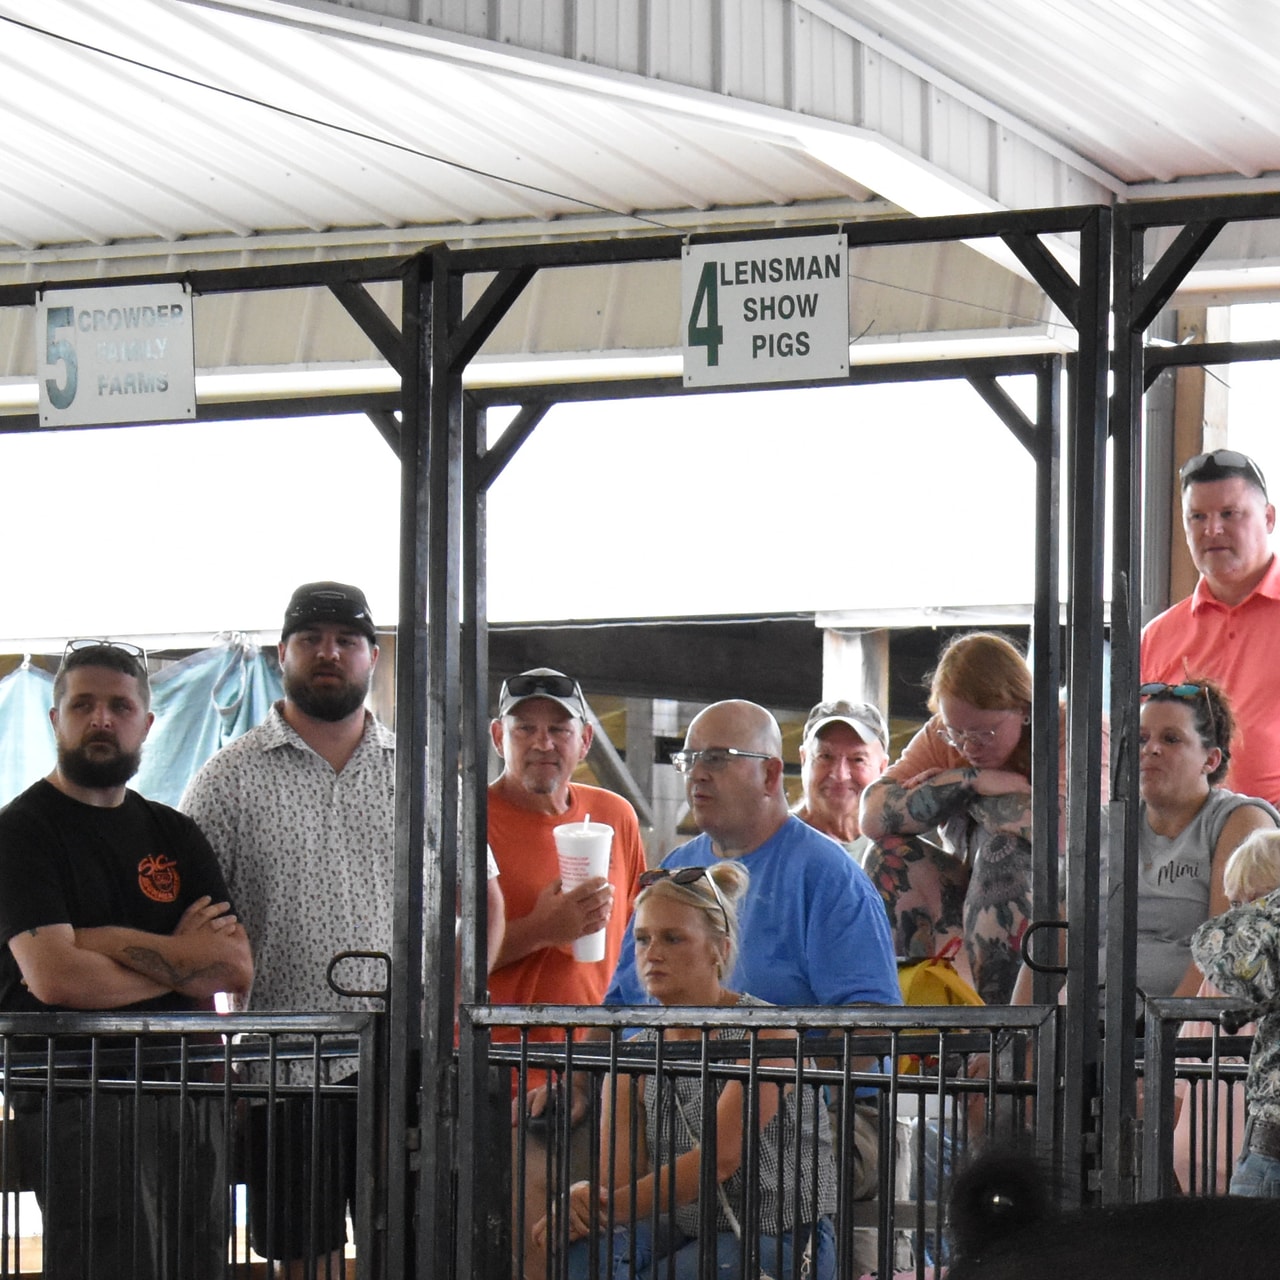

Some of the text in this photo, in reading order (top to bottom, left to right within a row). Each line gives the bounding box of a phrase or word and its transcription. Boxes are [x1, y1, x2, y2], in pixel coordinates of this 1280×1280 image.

[720, 253, 841, 287] LENSMAN
[78, 303, 184, 333] CROWDER
[688, 261, 723, 367] 4
[743, 293, 819, 323] SHOW
[46, 306, 78, 410] 5
[752, 331, 811, 359] PIGS
[98, 372, 169, 396] FARMS
[1158, 860, 1200, 886] Mimi
